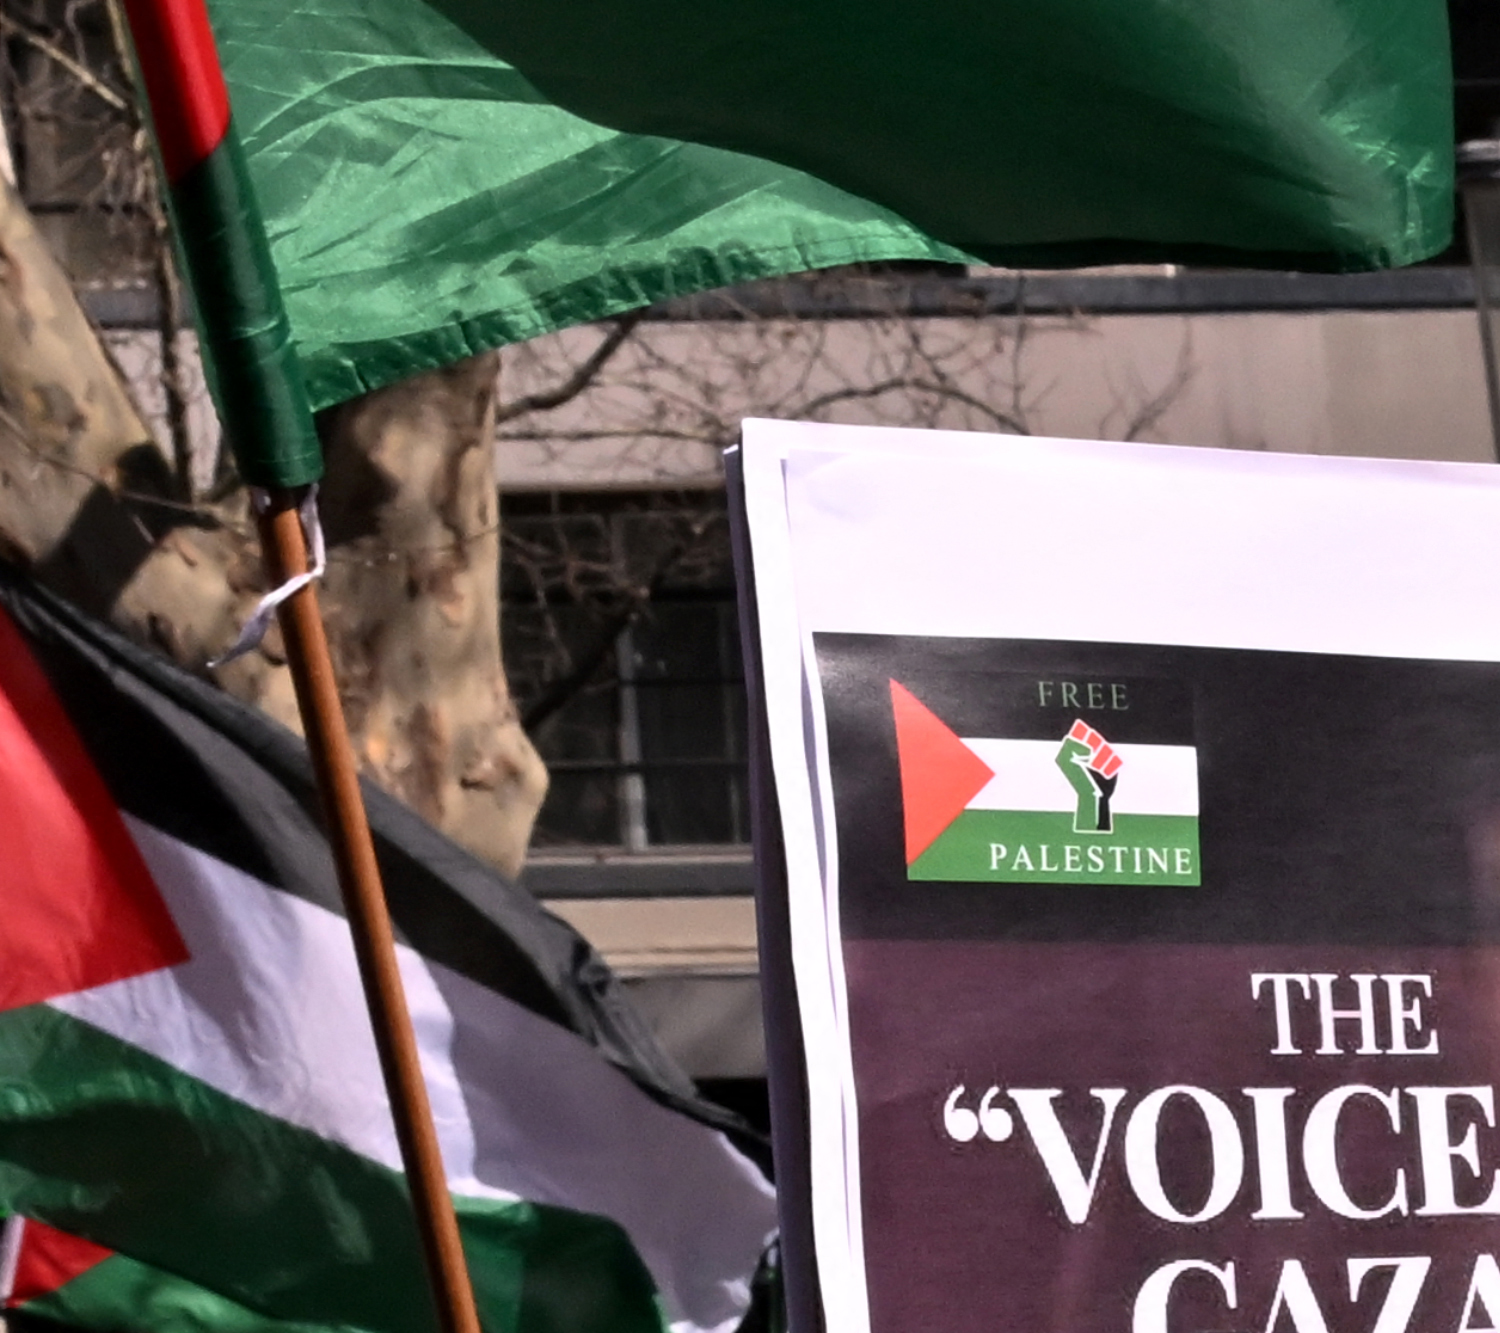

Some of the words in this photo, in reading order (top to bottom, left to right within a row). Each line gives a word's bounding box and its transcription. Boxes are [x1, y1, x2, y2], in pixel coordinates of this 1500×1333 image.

[1037, 681, 1130, 711] FREE
[989, 843, 1192, 874] PALESTINE
[1251, 972, 1439, 1056] THE
